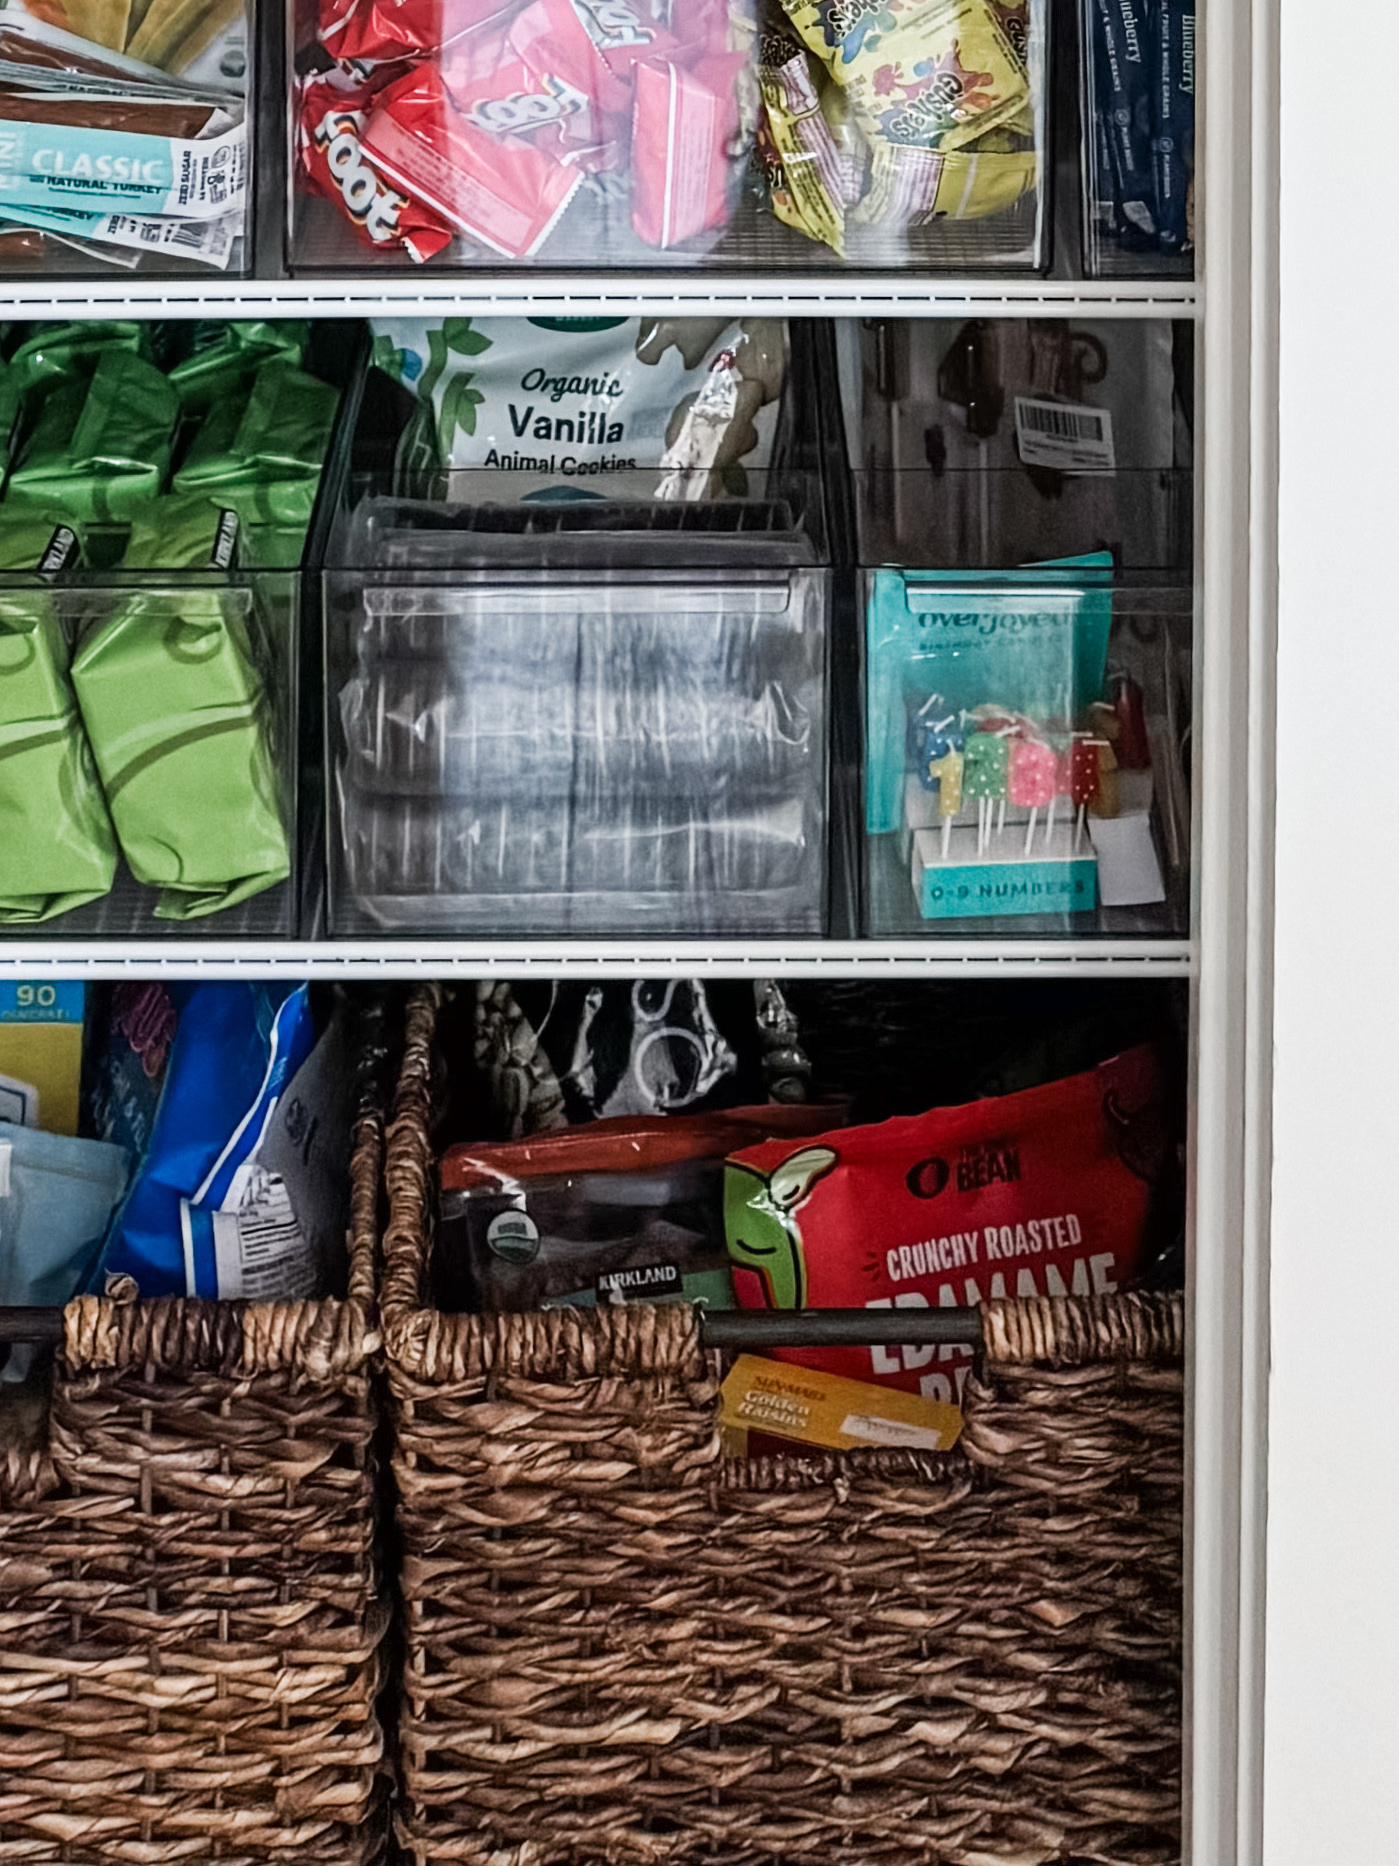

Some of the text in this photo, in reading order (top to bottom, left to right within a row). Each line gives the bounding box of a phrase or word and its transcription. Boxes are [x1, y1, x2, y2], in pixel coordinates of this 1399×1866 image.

[1179, 14, 1195, 95] Blueberry
[32, 149, 165, 184] CLASSIC
[179, 151, 192, 183] SUGAR
[47, 176, 163, 195] NATURAL TURKEY
[521, 368, 623, 399] Organic
[508, 404, 624, 445] Vanilla
[484, 449, 636, 477] Animal Cookies
[931, 878, 1086, 900] 0-9 NUMBERS
[17, 985, 56, 1007] 90
[957, 1151, 1022, 1193] BEAN
[886, 1213, 1082, 1281] CRUNCHY ROASTED
[600, 1266, 677, 1292] KIRKLAND
[737, 1399, 810, 1430] Raisins
[744, 1389, 810, 1417] Golden
